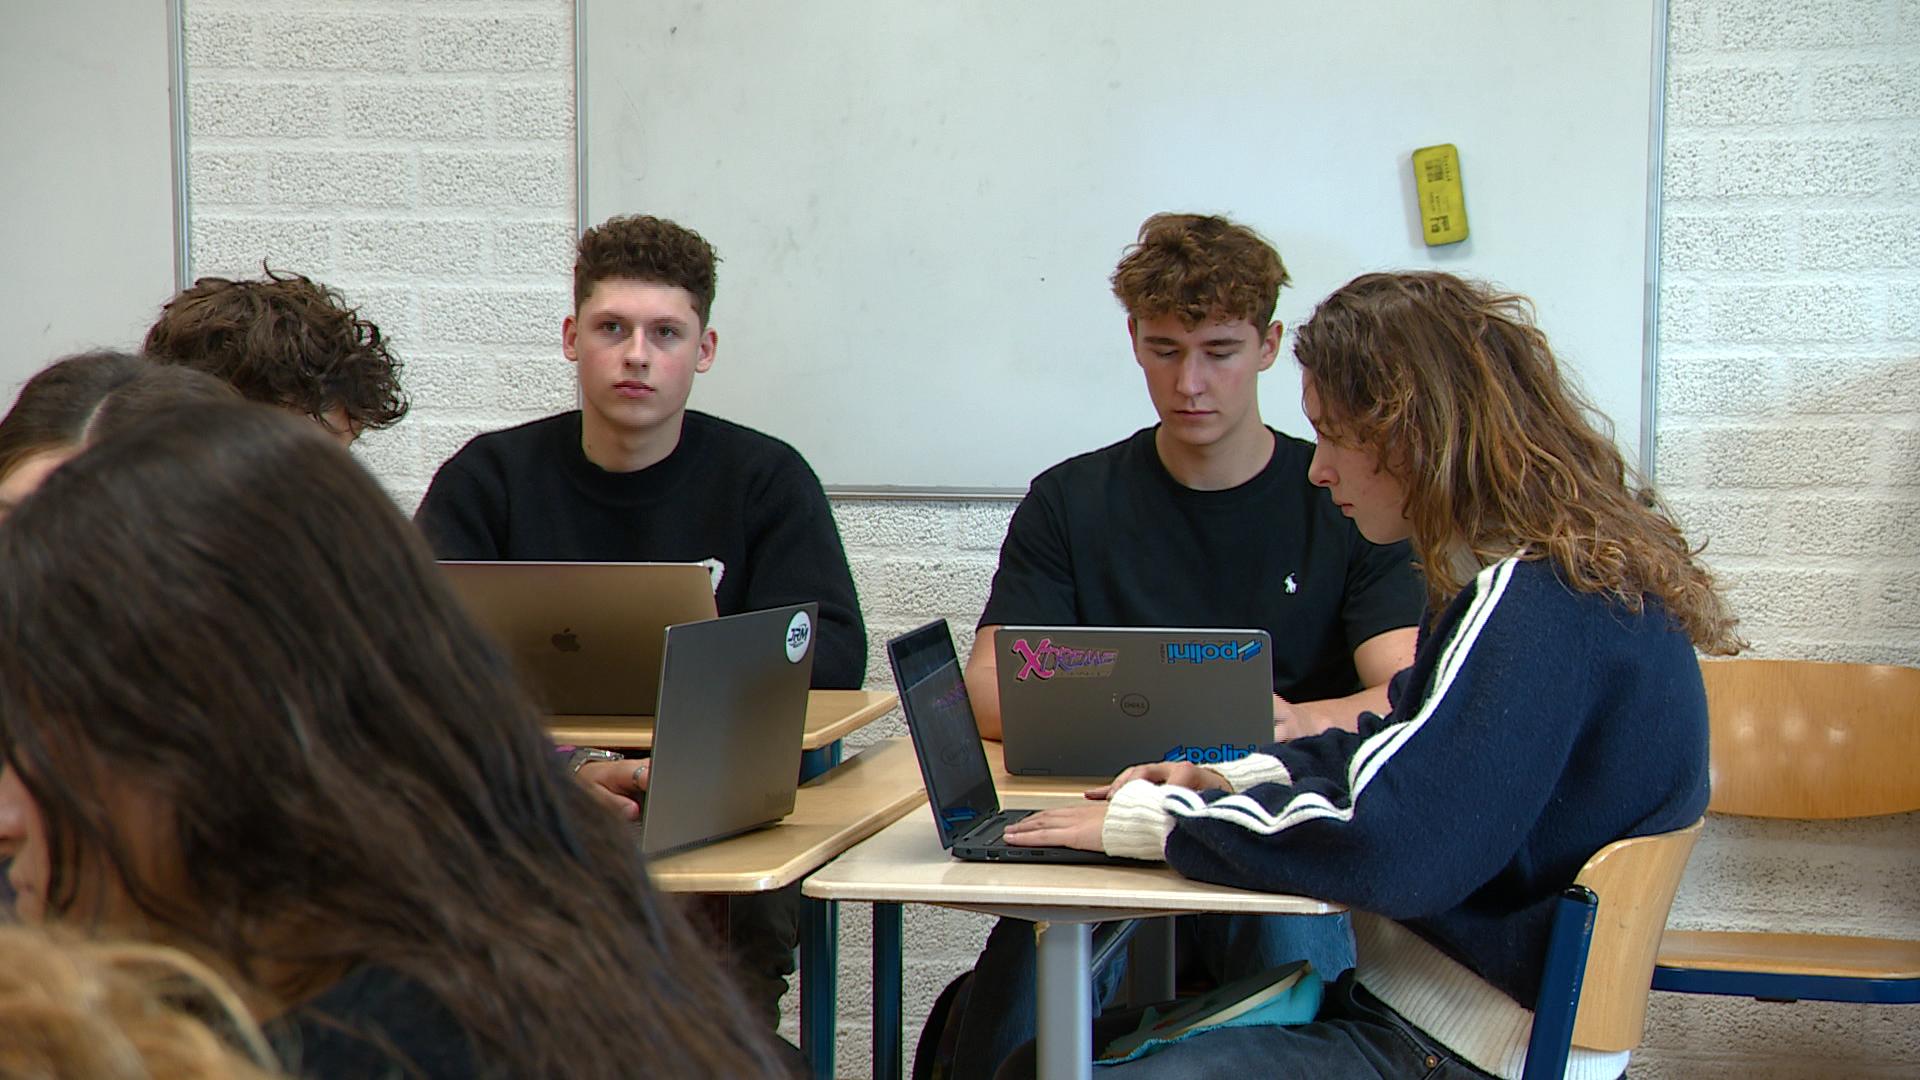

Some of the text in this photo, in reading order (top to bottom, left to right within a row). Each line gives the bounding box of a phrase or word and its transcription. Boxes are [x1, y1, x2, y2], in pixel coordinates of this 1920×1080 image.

[788, 628, 808, 642] JRM
[1167, 641, 1238, 664] polini
[1185, 744, 1256, 764] polin
